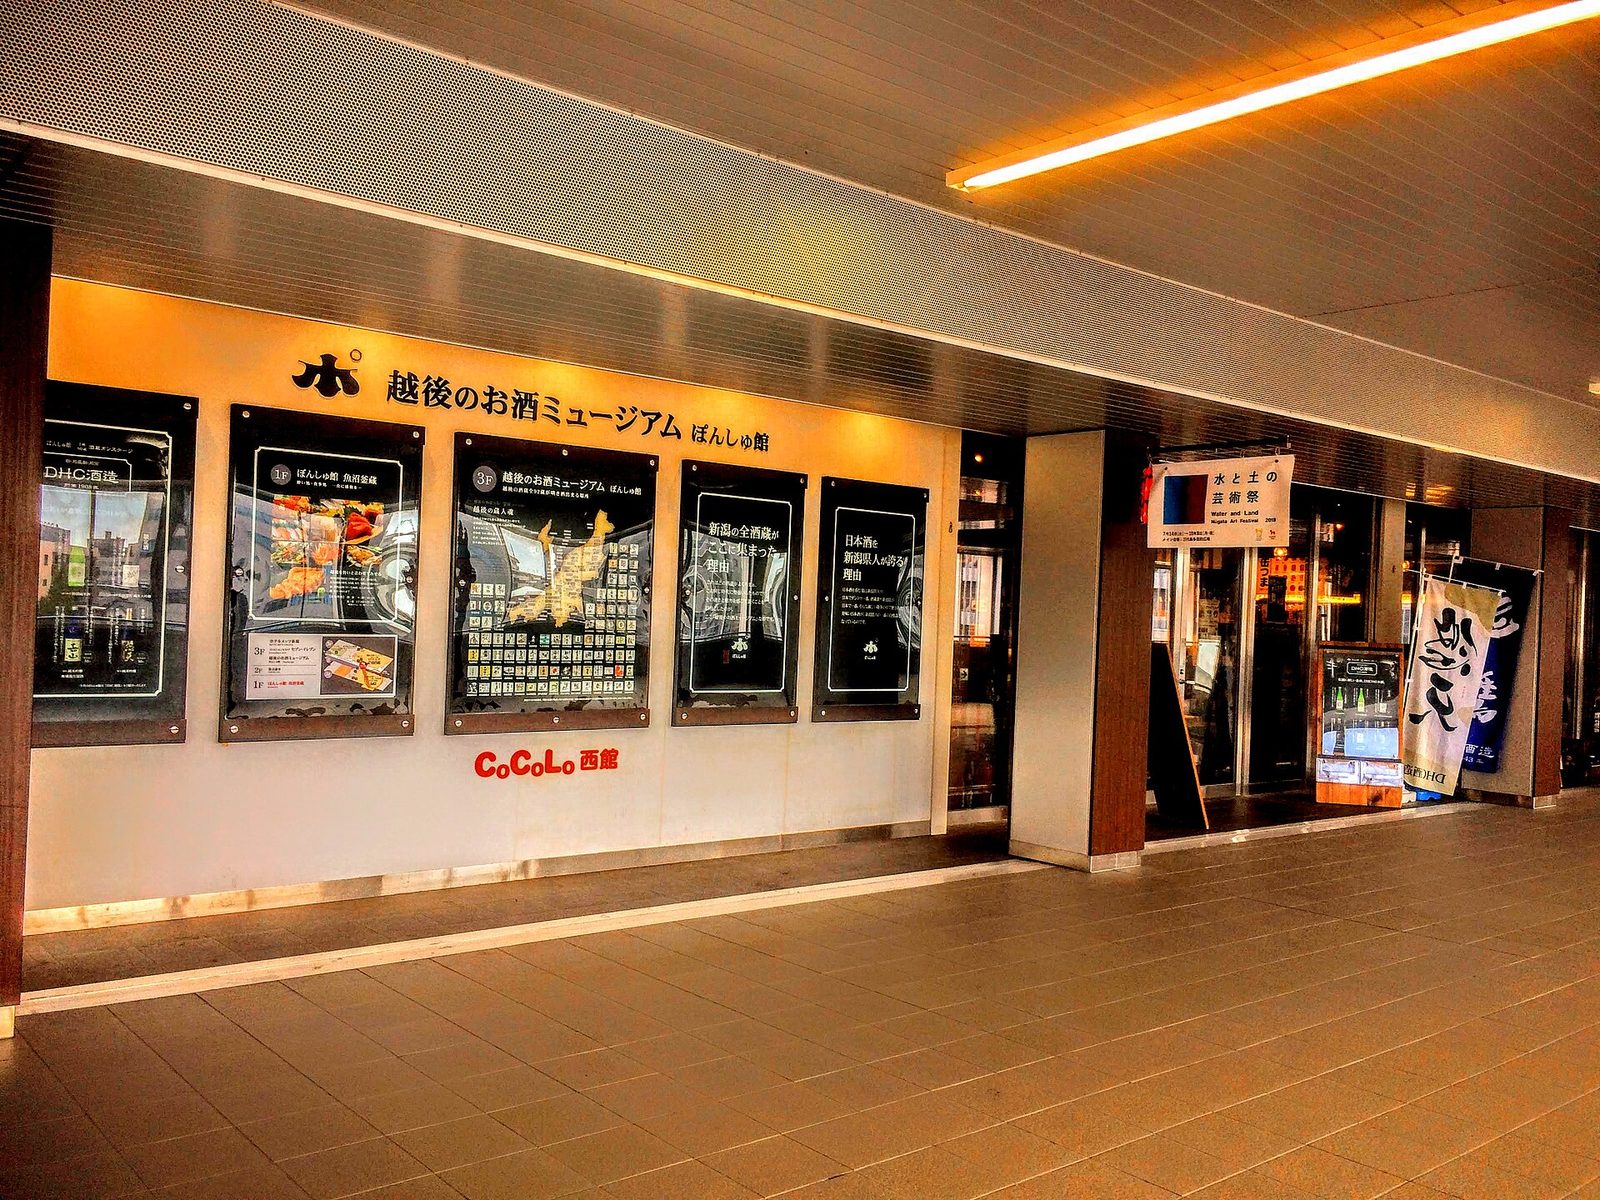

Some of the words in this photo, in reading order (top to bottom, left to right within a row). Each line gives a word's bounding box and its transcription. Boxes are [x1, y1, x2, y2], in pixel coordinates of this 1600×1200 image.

[386, 369, 682, 439] 越後のお酒ミュージアム
[691, 423, 769, 452] ぽんしゅ館
[43, 466, 119, 484] DHC酒造
[274, 469, 289, 480] 1F
[296, 468, 339, 481] ぽんしゅ館
[343, 472, 378, 485] 魚沼釜蔵
[477, 472, 493, 486] 3F
[502, 471, 605, 492] 越後のお酒ミュージアム
[609, 485, 642, 496] ぽんしゅ館
[1213, 470, 1278, 485] 水と土の
[1212, 490, 1259, 505] 芸術祭
[708, 521, 780, 541] 新潟の全酒蔵が
[708, 541, 777, 558] ここに集まった
[845, 534, 879, 549] 日本酒を
[706, 558, 730, 573] 理由
[843, 551, 904, 568] 新潟県人が誇る
[843, 568, 862, 581] 理由
[254, 647, 265, 656] 3F
[253, 680, 265, 689] 1F
[474, 749, 576, 780] CoCoLo
[580, 748, 619, 771] 西館
